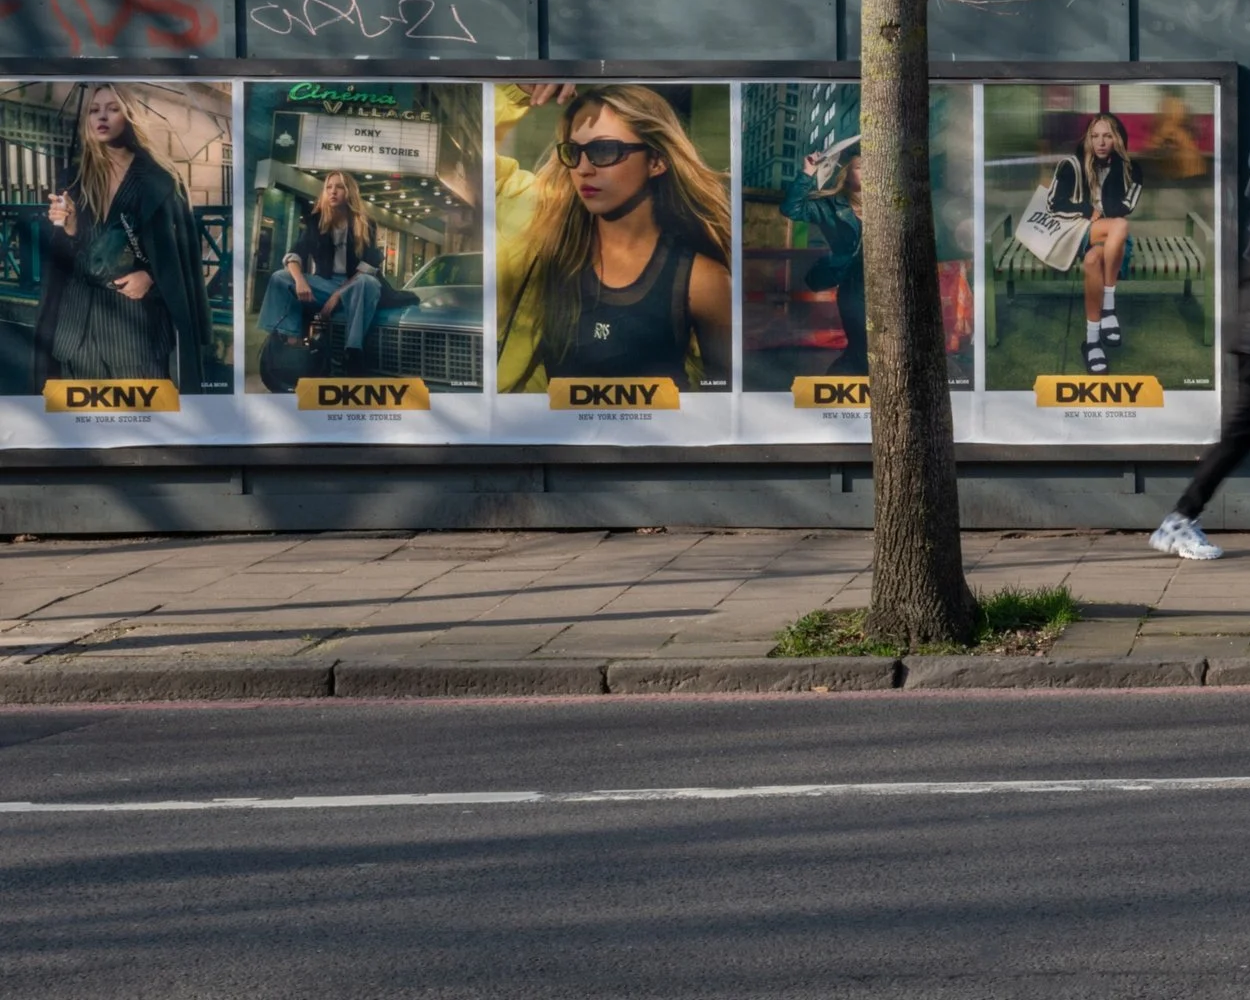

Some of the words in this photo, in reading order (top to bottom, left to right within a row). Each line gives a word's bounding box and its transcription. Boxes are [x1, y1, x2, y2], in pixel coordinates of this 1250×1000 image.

[322, 100, 432, 122] VILLAGE
[354, 128, 381, 138] DKNY
[321, 142, 342, 151] NEW
[347, 144, 374, 154] YORK
[378, 146, 420, 157] STORIES
[1027, 211, 1062, 237] DKNY
[66, 386, 159, 408] DKNY
[318, 384, 410, 406] DKNY
[569, 384, 660, 406] DKNY
[1056, 382, 1144, 403] DKNY
[118, 415, 151, 423] STORIES
[619, 413, 652, 421] STORIES
